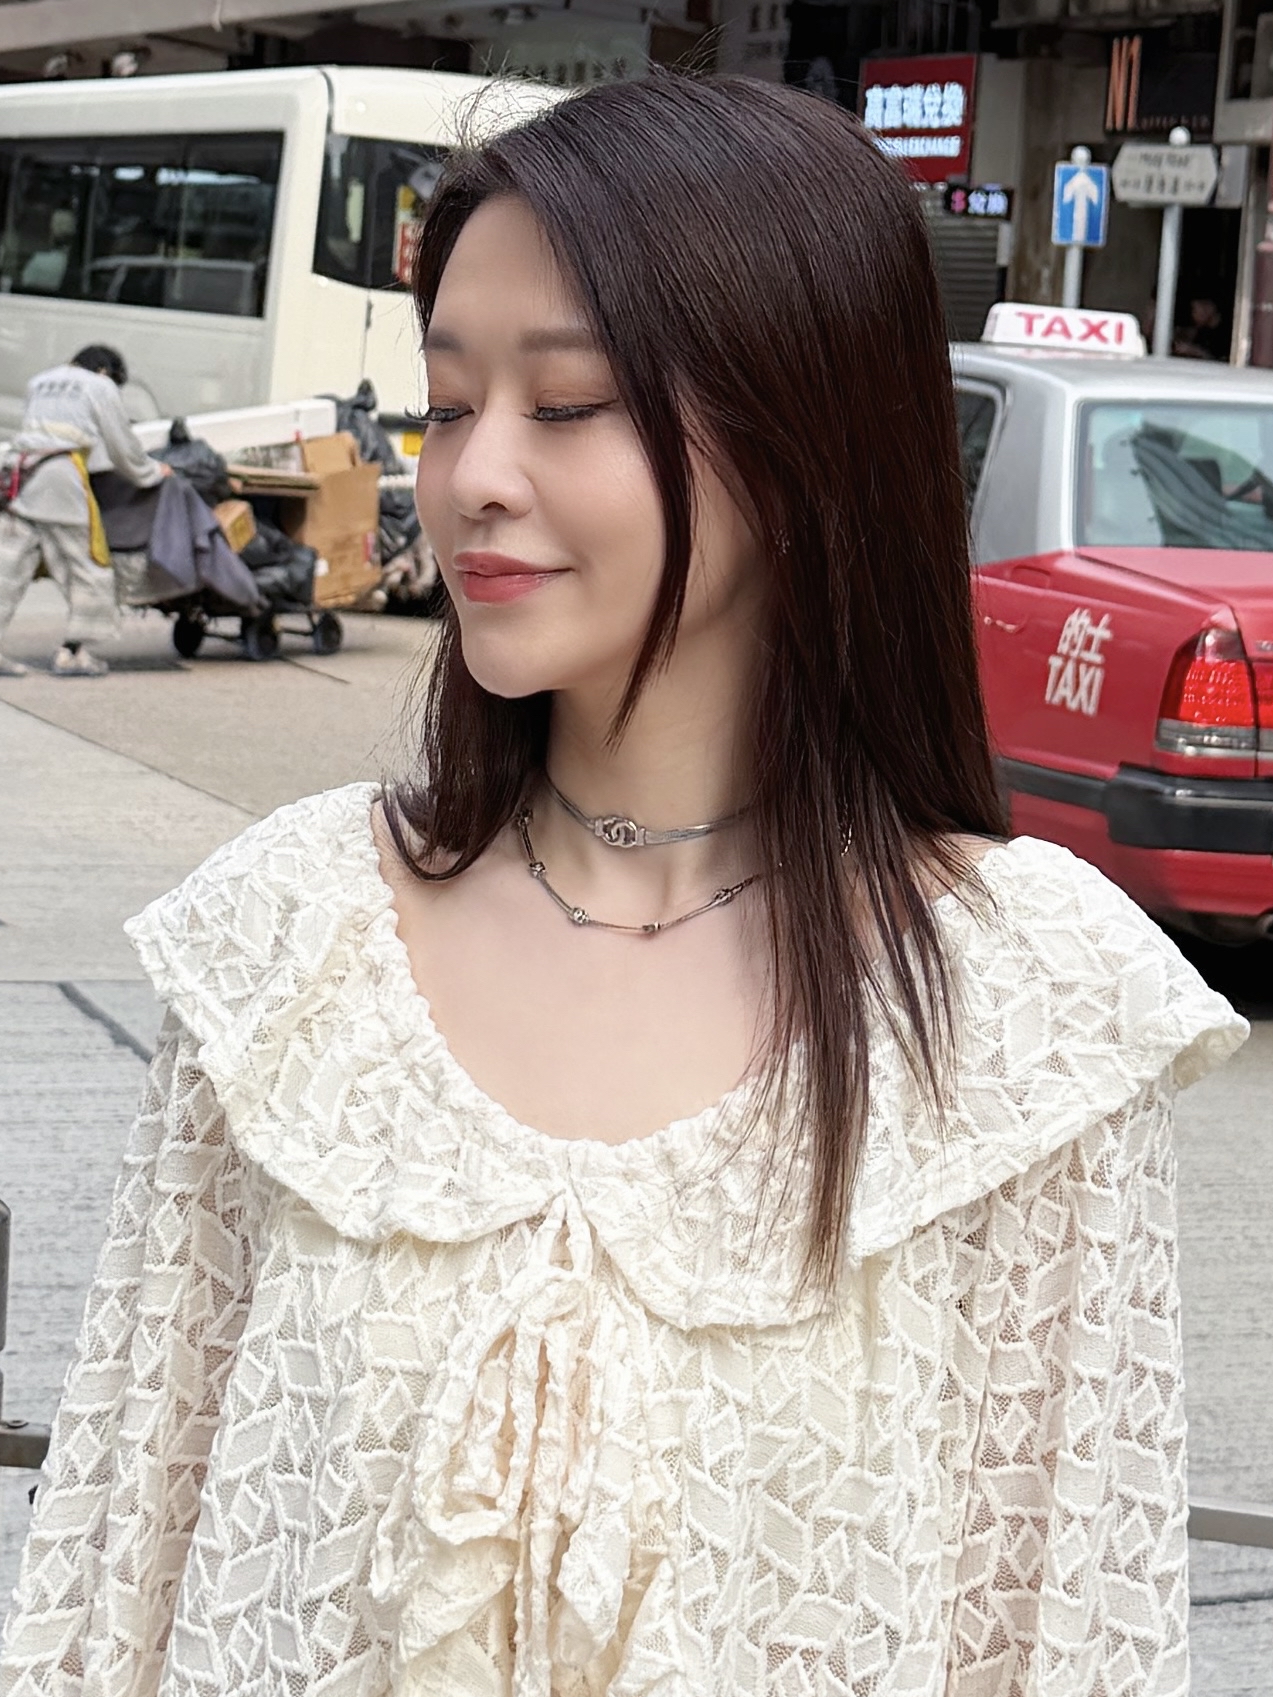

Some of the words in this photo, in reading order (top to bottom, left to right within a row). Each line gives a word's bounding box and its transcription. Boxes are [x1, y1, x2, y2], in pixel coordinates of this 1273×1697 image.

[1015, 311, 1124, 345] TAXI
[1056, 607, 1113, 664] 的士
[1045, 654, 1105, 717] TAXI
